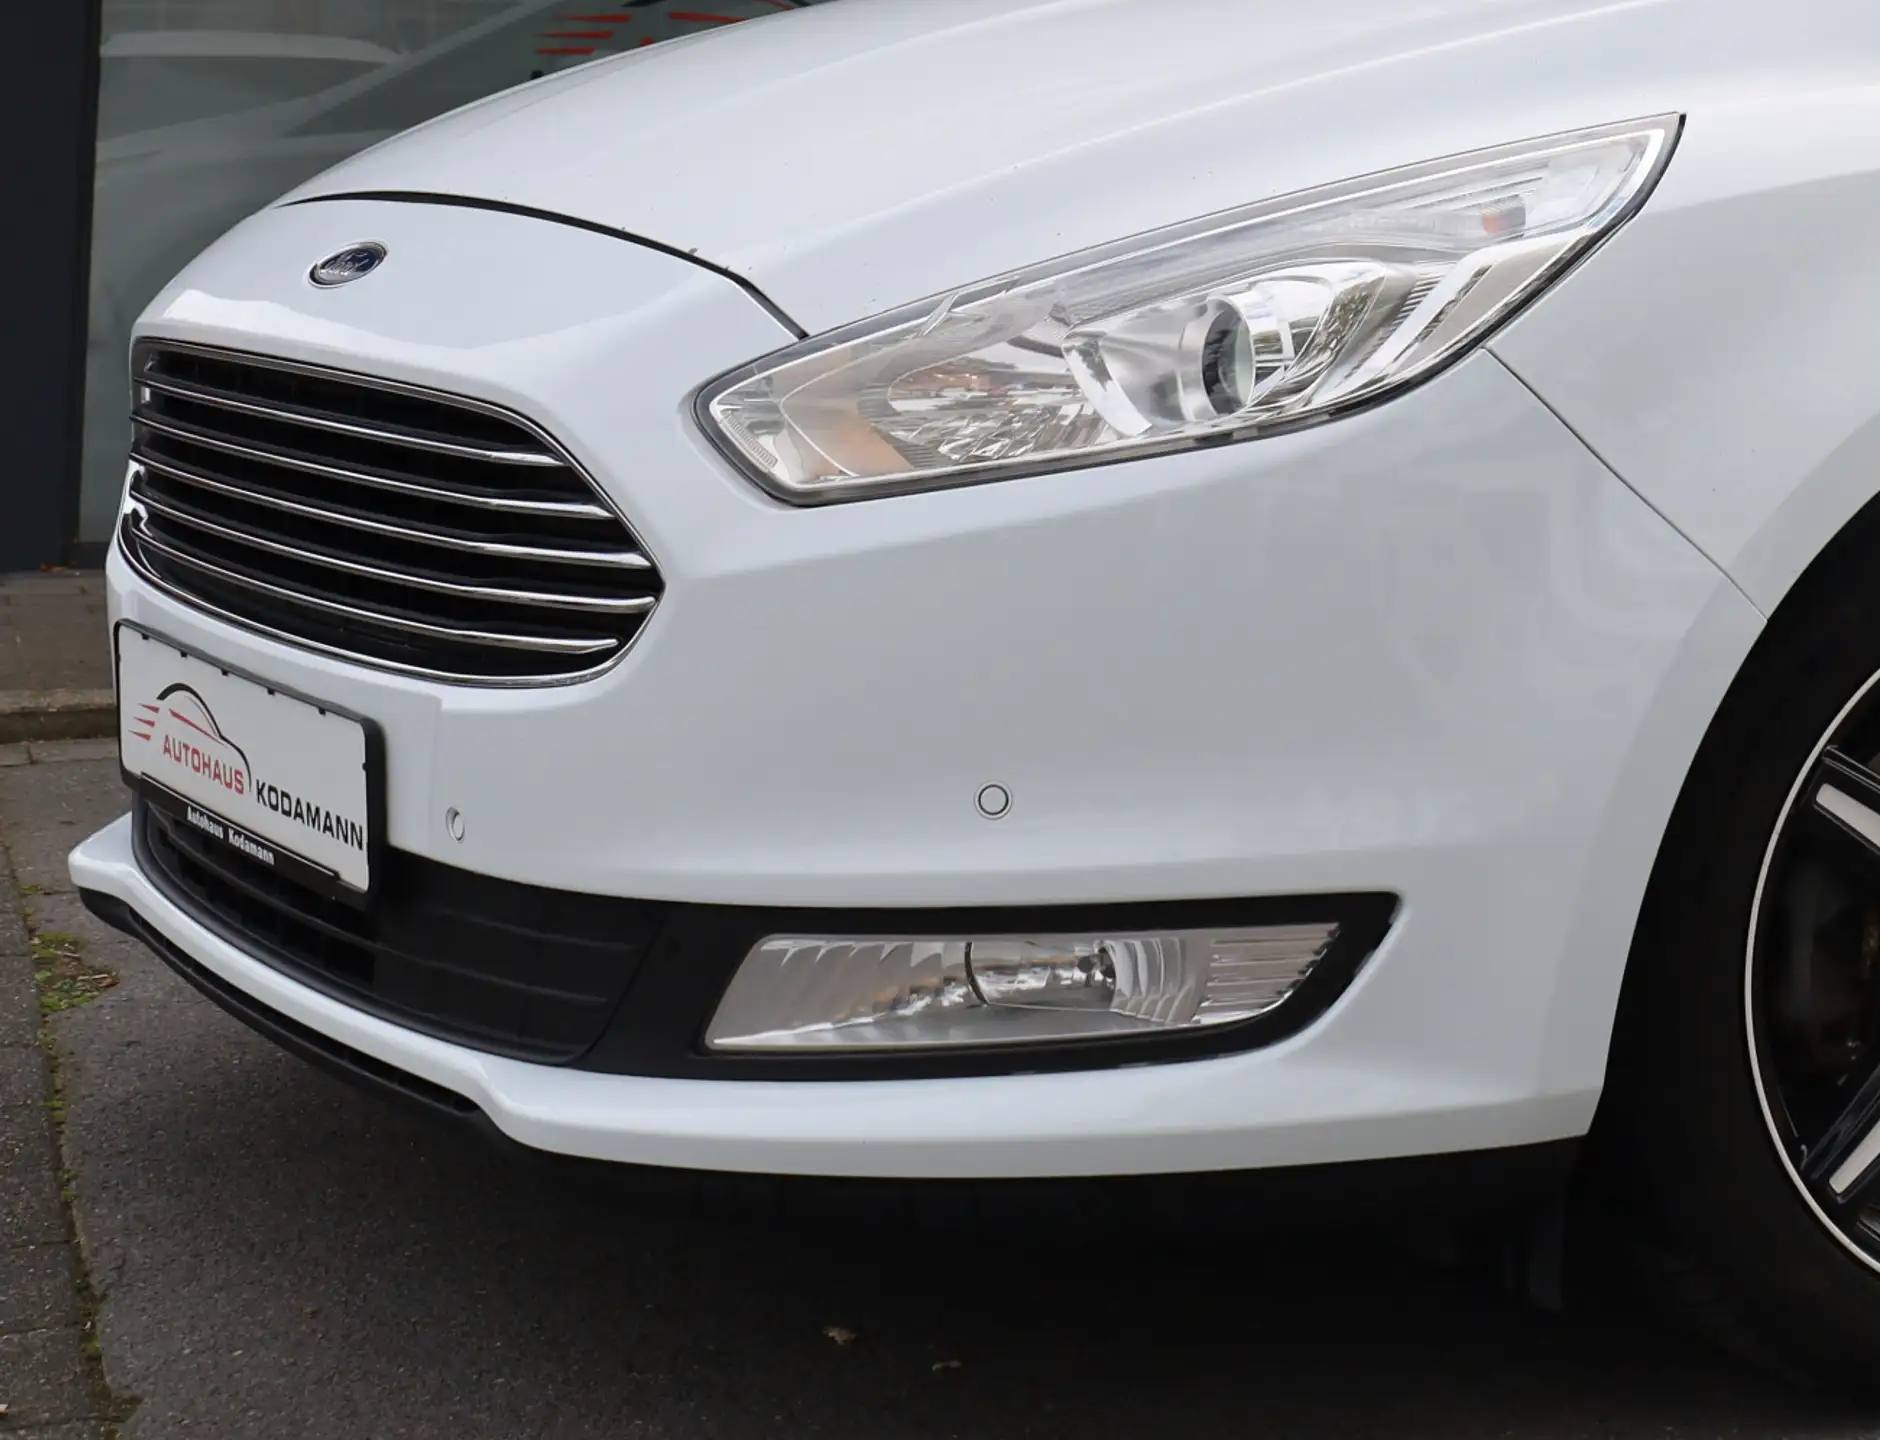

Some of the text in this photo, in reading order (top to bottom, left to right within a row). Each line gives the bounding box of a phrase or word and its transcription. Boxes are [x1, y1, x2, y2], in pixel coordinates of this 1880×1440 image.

[163, 734, 363, 851] AUTOHAUS KODAMANN
[187, 806, 275, 866] Autohaus Kodamann
